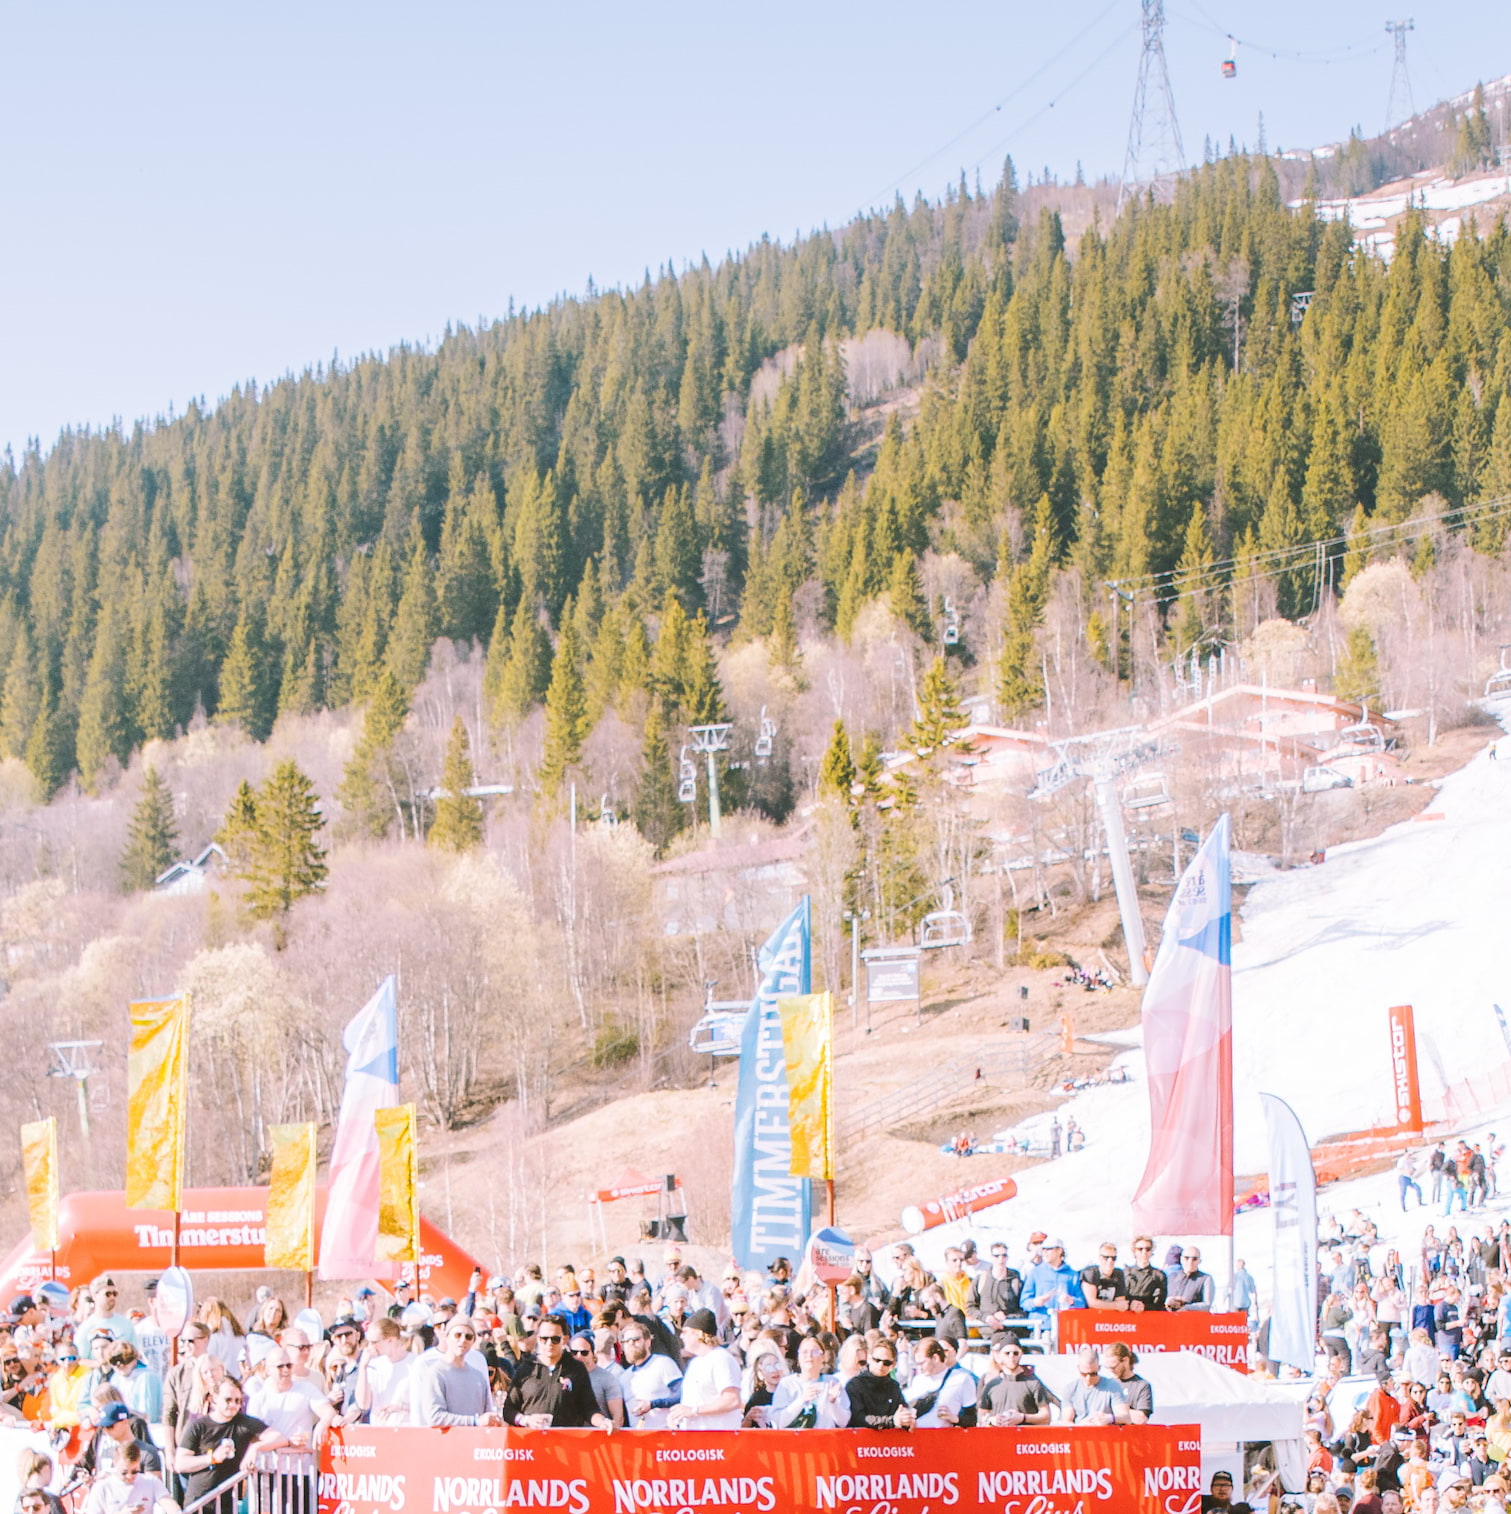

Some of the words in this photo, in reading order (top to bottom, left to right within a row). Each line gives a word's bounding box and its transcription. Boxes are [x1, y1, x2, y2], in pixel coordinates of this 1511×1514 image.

[1095, 1323, 1137, 1332] EKOLOGISK
[473, 1448, 534, 1461] EKOLOGISK
[655, 1448, 725, 1462] EKOLOGISK
[857, 1446, 915, 1458] EKOLOGISK
[1016, 1443, 1071, 1455] EKOLOGISK
[815, 1472, 960, 1509] NORRLANDS
[977, 1467, 1114, 1504] NORRLANDS
[612, 1475, 776, 1514] NORRLANDS
